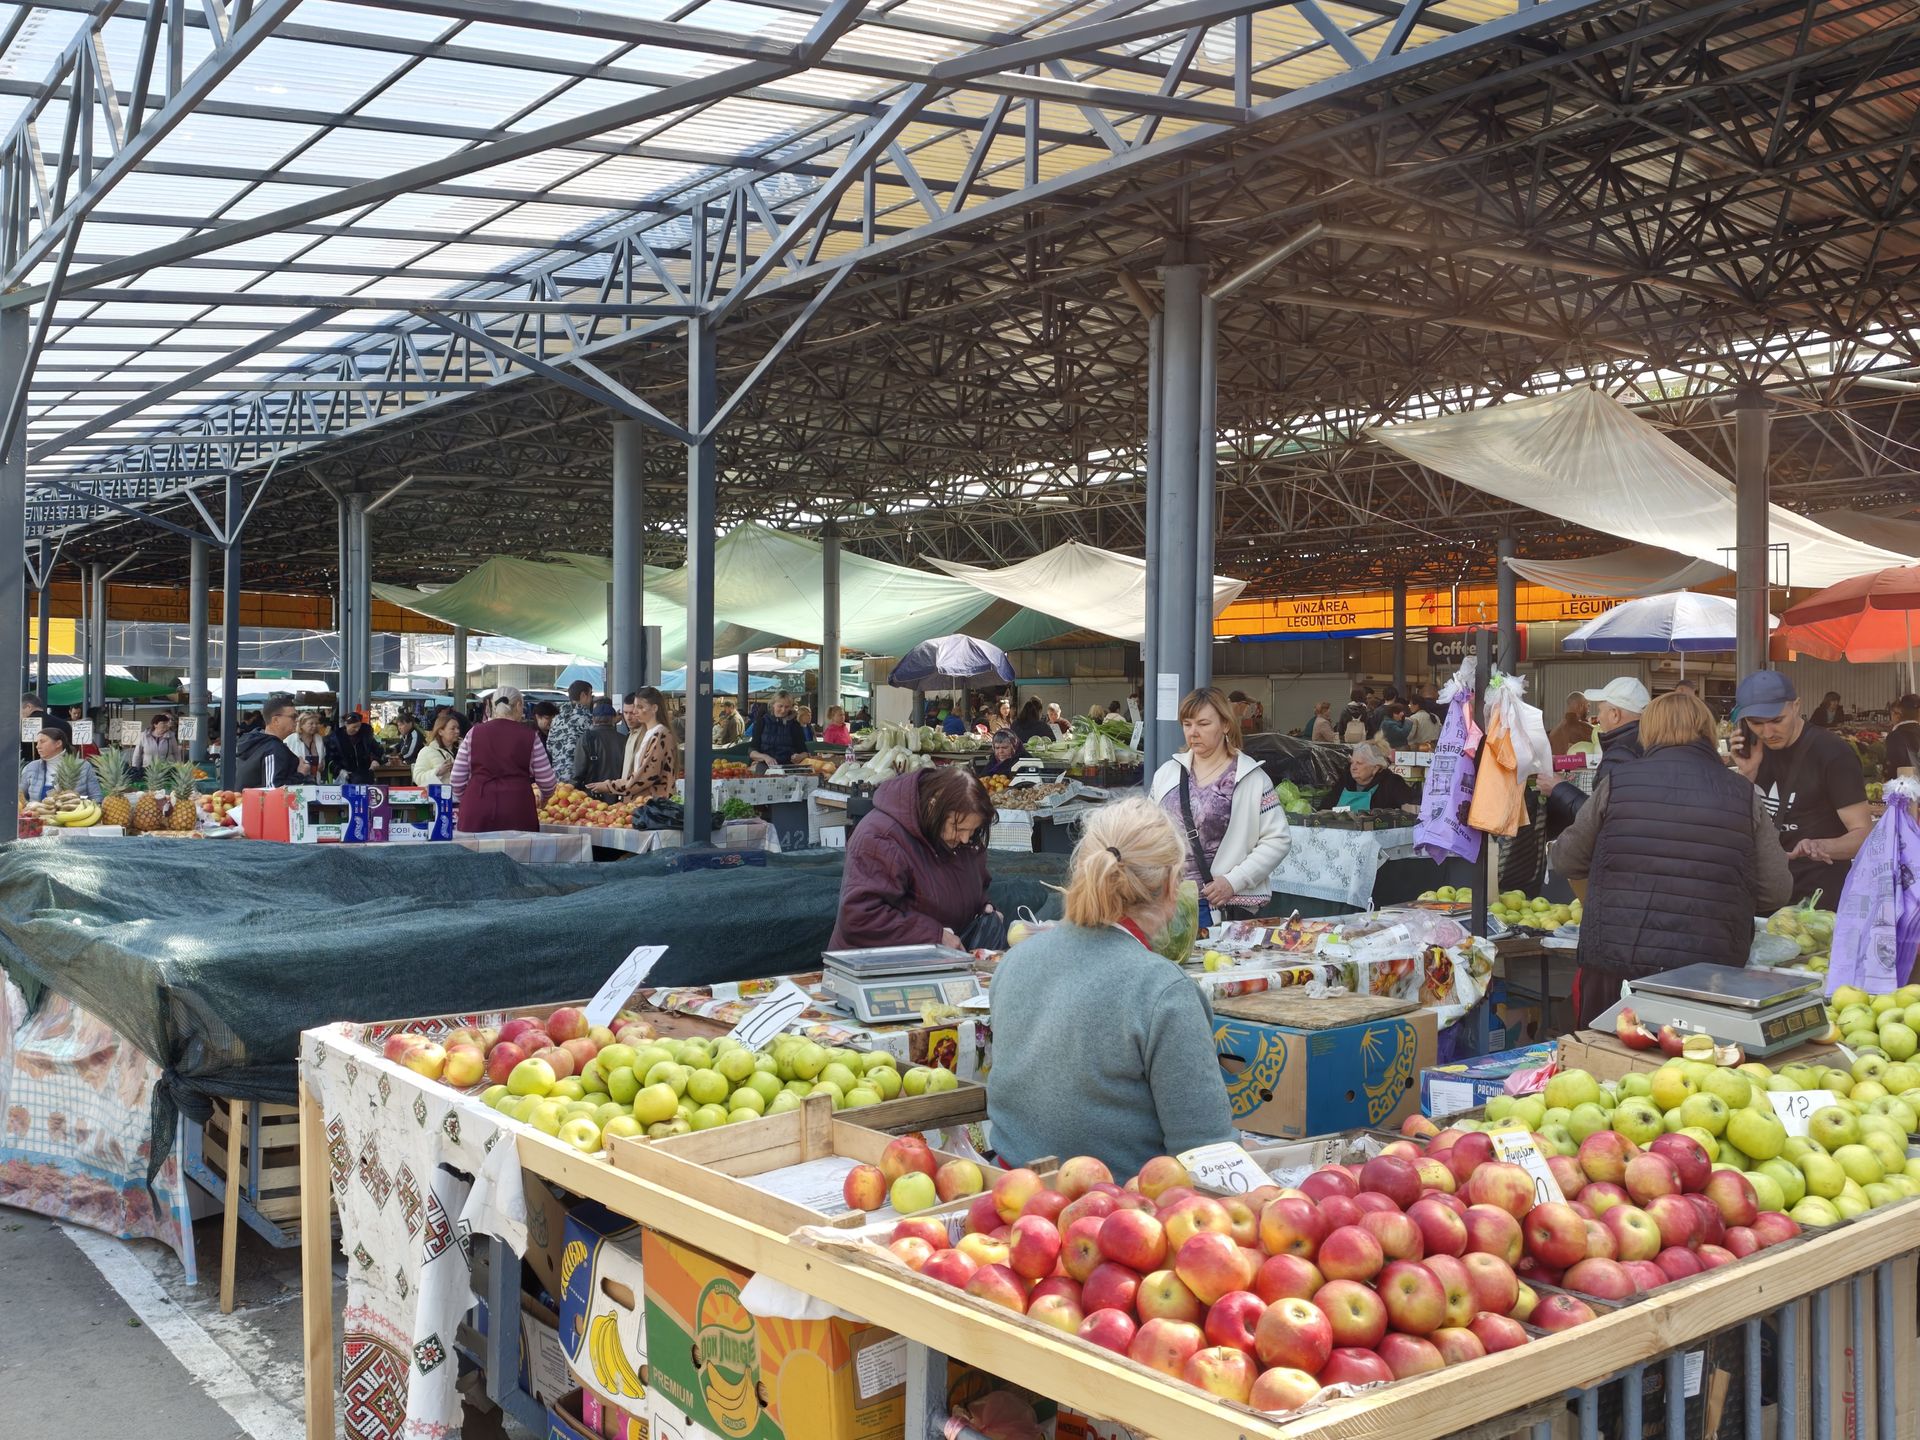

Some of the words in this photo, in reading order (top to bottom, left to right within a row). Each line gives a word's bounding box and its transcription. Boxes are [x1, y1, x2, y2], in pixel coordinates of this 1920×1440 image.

[1287, 613, 1356, 628] LEGUMELOR
[1432, 641, 1477, 656] Coffee
[1230, 1035, 1286, 1117] anaBay
[1368, 1025, 1416, 1125] BanaBay
[1786, 1096, 1810, 1119] 12
[652, 1366, 694, 1409] PREMIUM
